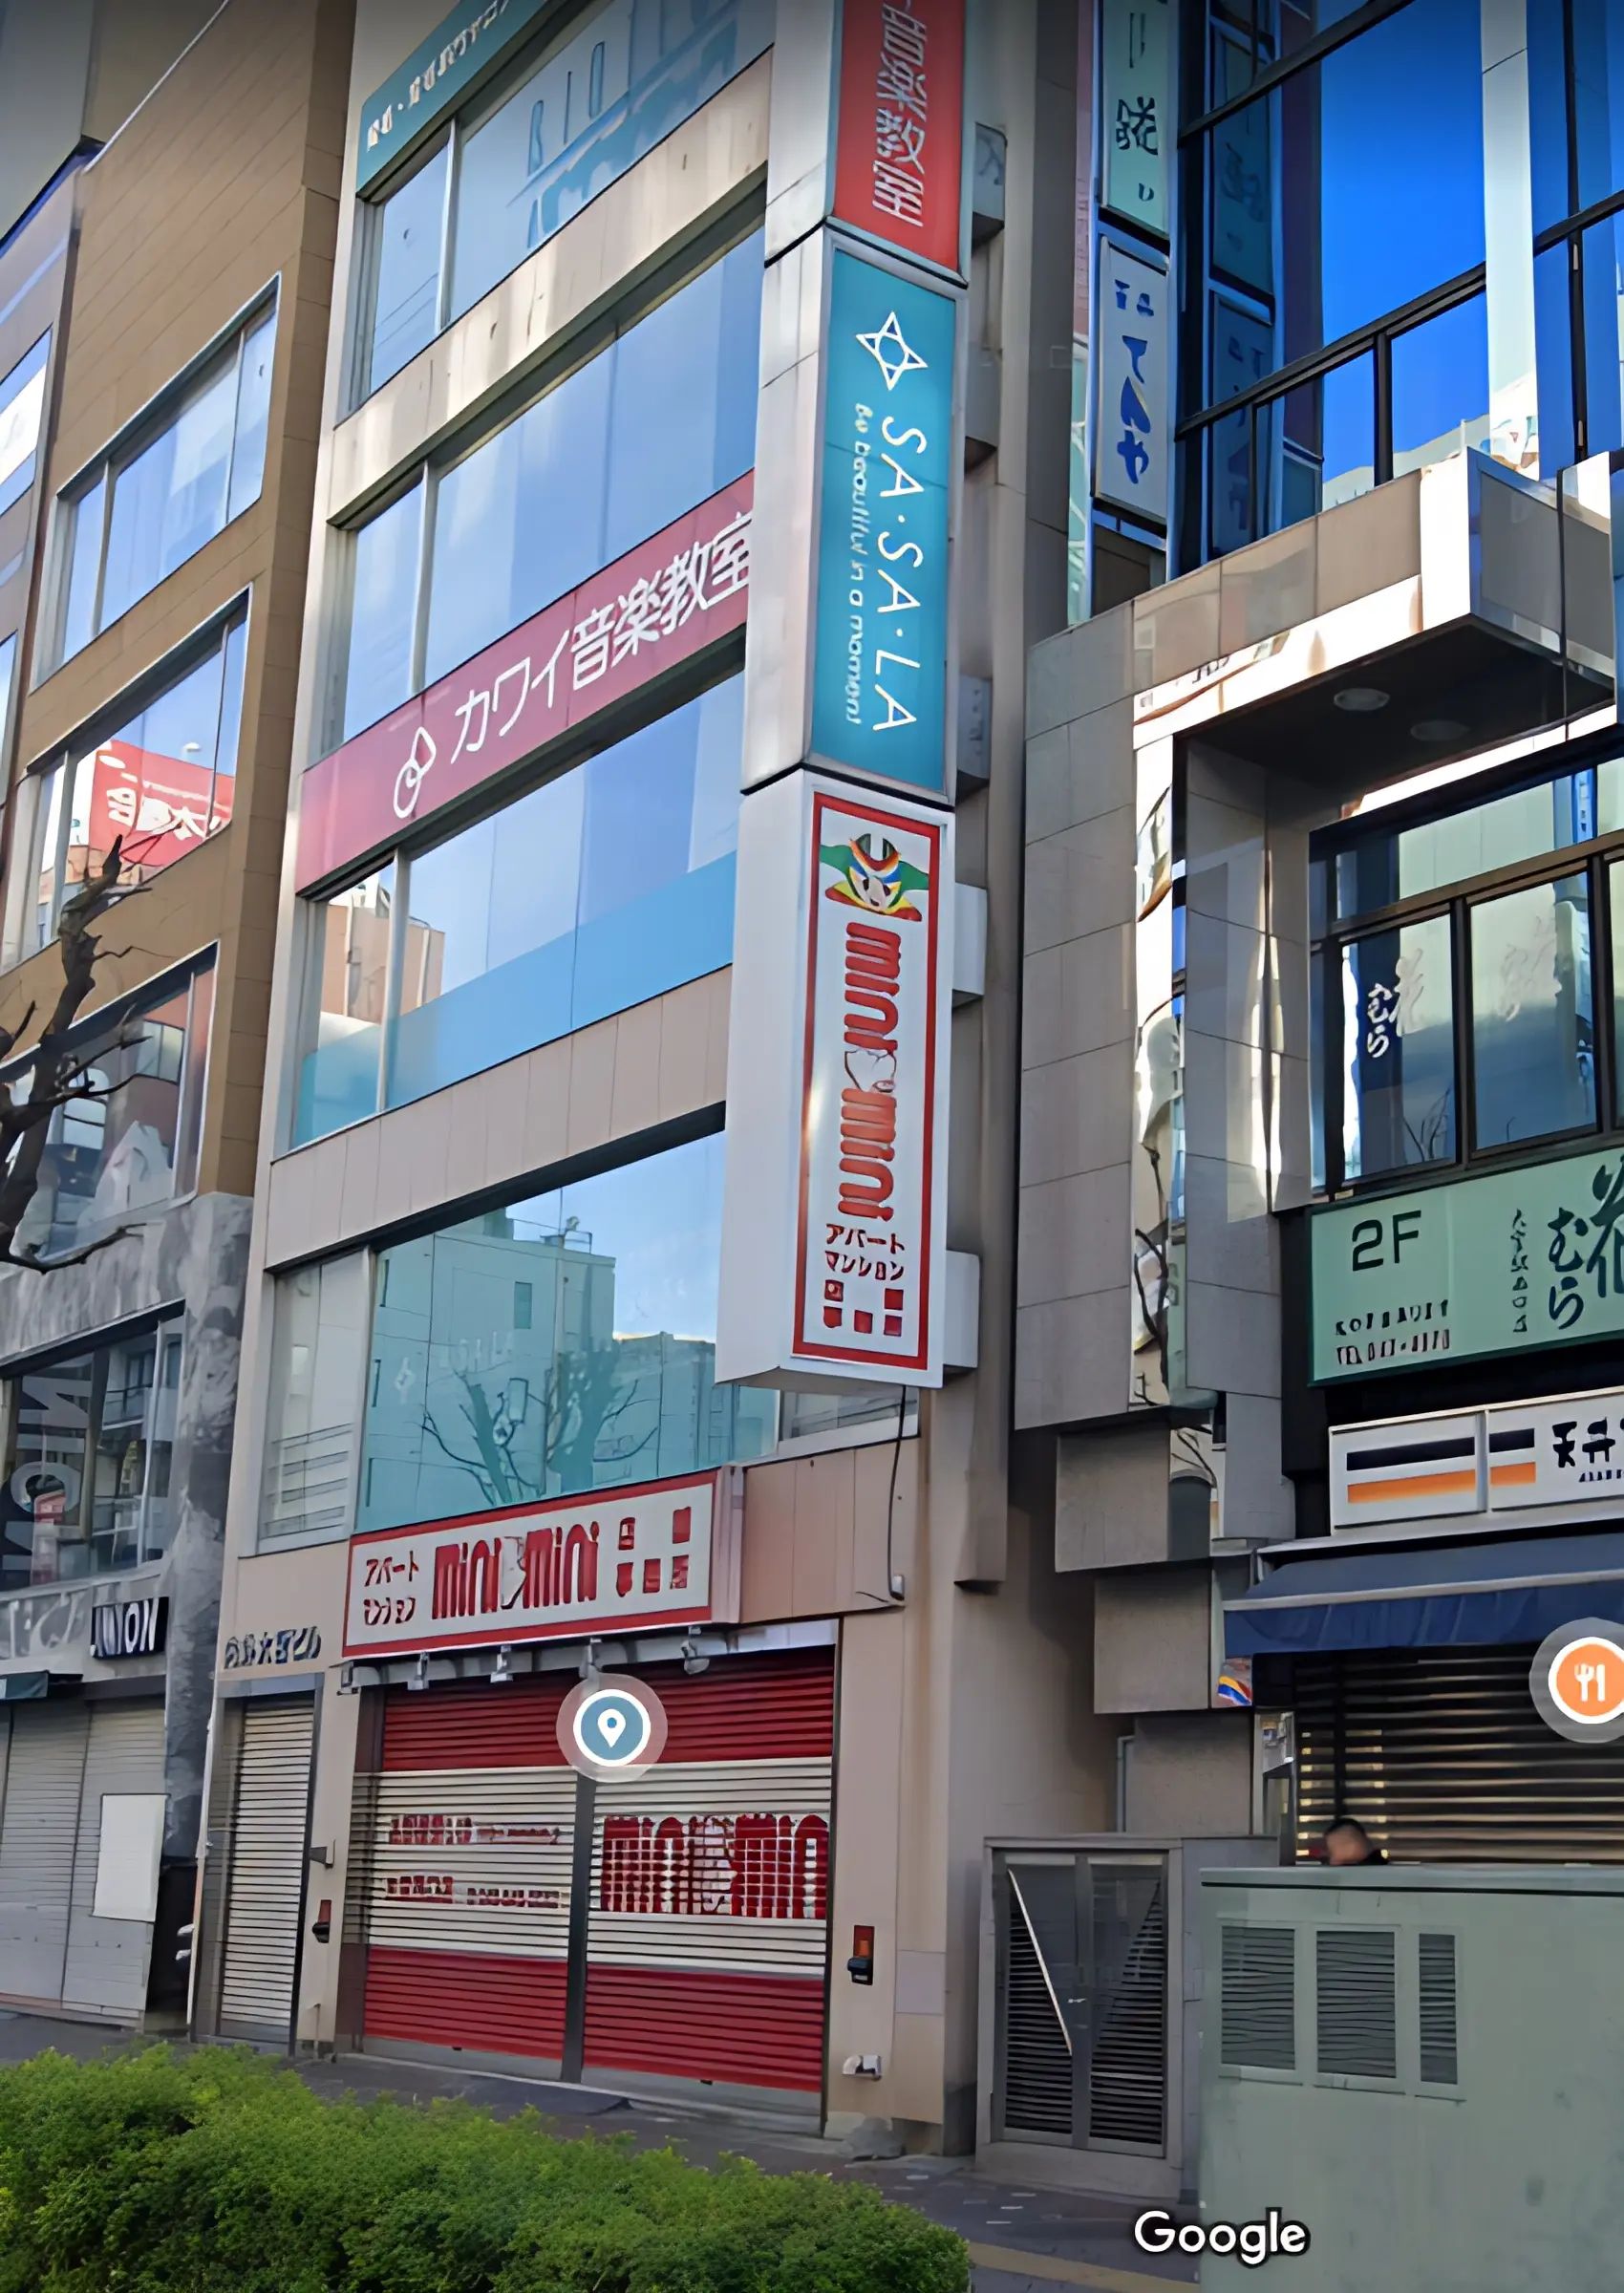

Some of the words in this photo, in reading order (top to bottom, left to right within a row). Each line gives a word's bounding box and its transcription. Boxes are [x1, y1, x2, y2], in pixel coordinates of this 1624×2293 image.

[451, 511, 752, 764] カワイ音楽教室
[1352, 1210, 1421, 1272] 2F
